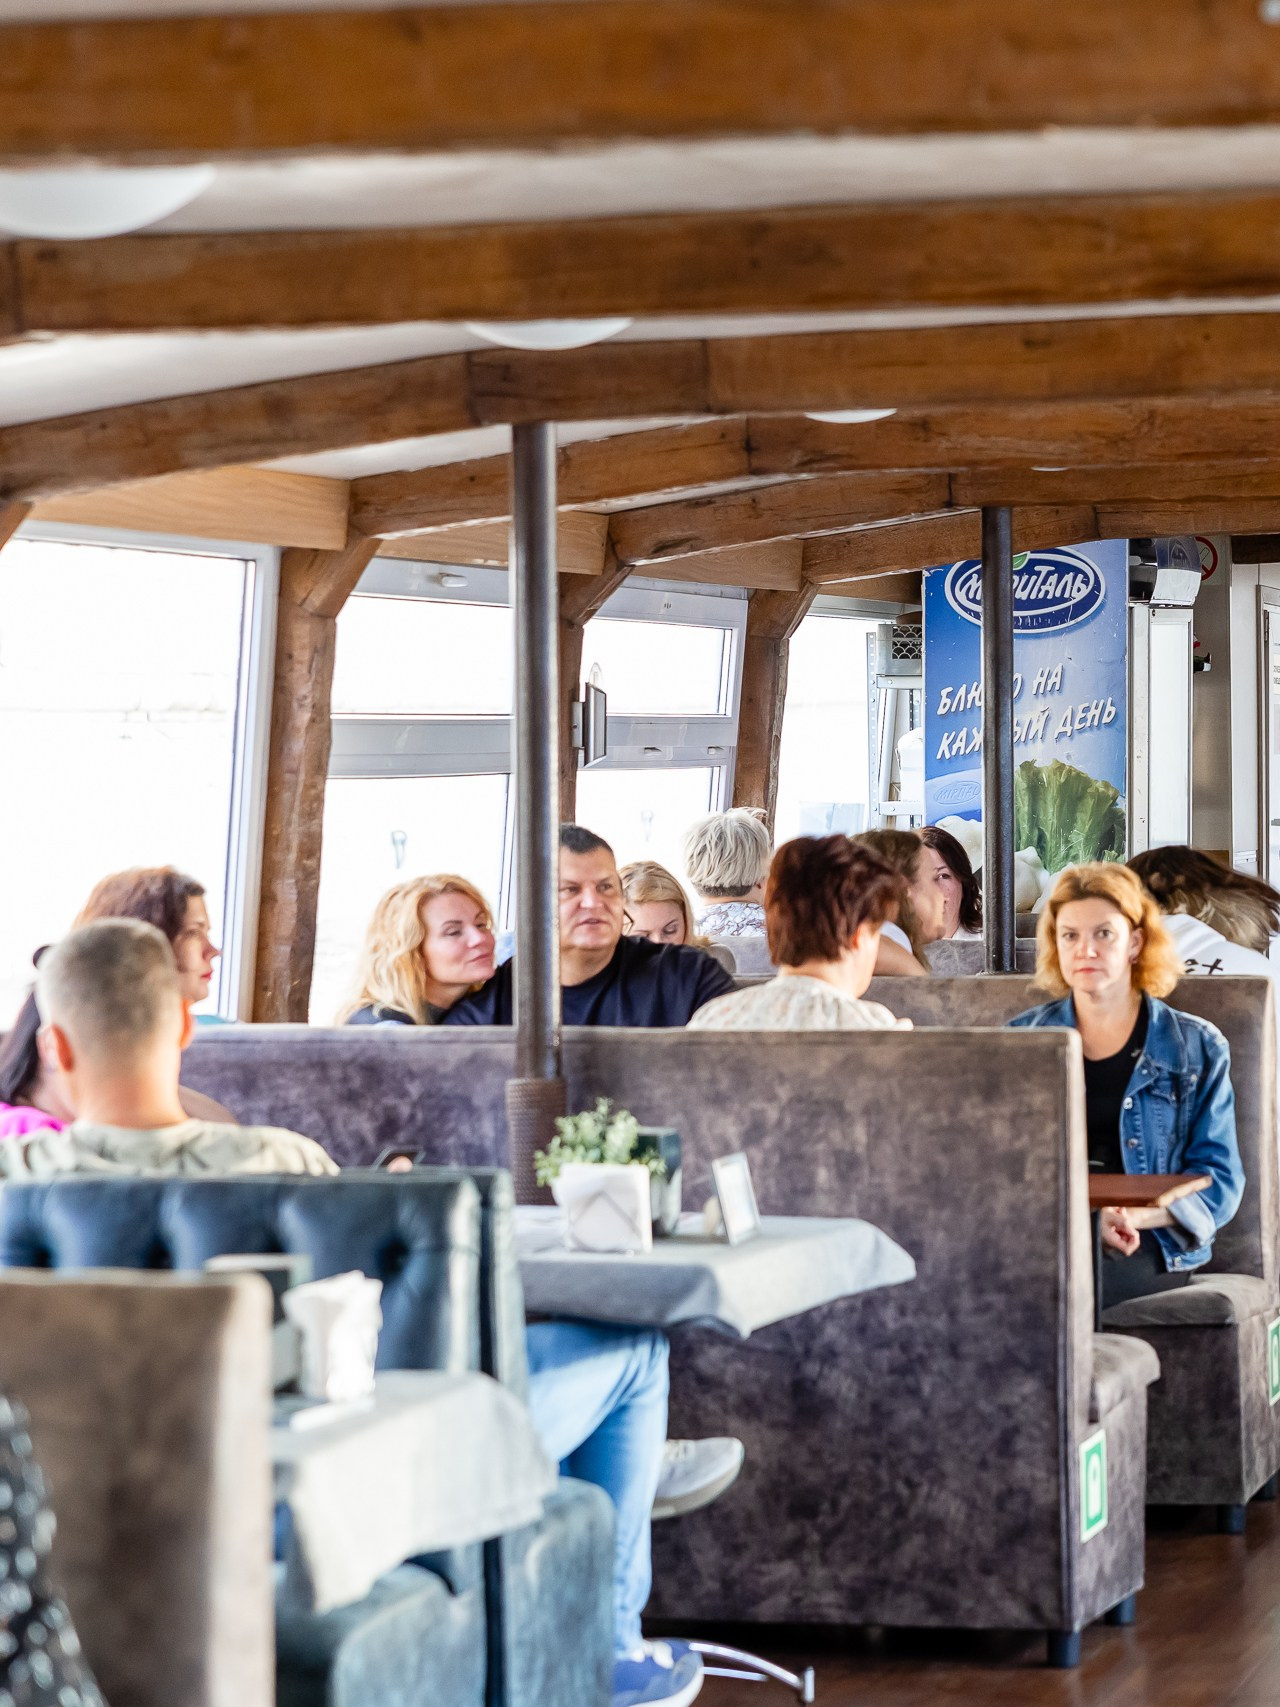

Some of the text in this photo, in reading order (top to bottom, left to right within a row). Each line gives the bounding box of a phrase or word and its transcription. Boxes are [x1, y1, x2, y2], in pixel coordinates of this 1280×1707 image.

[937, 662, 1064, 716] БЛЮО НА
[936, 697, 1116, 760] КАЖЫЙ ДЕНЬ
